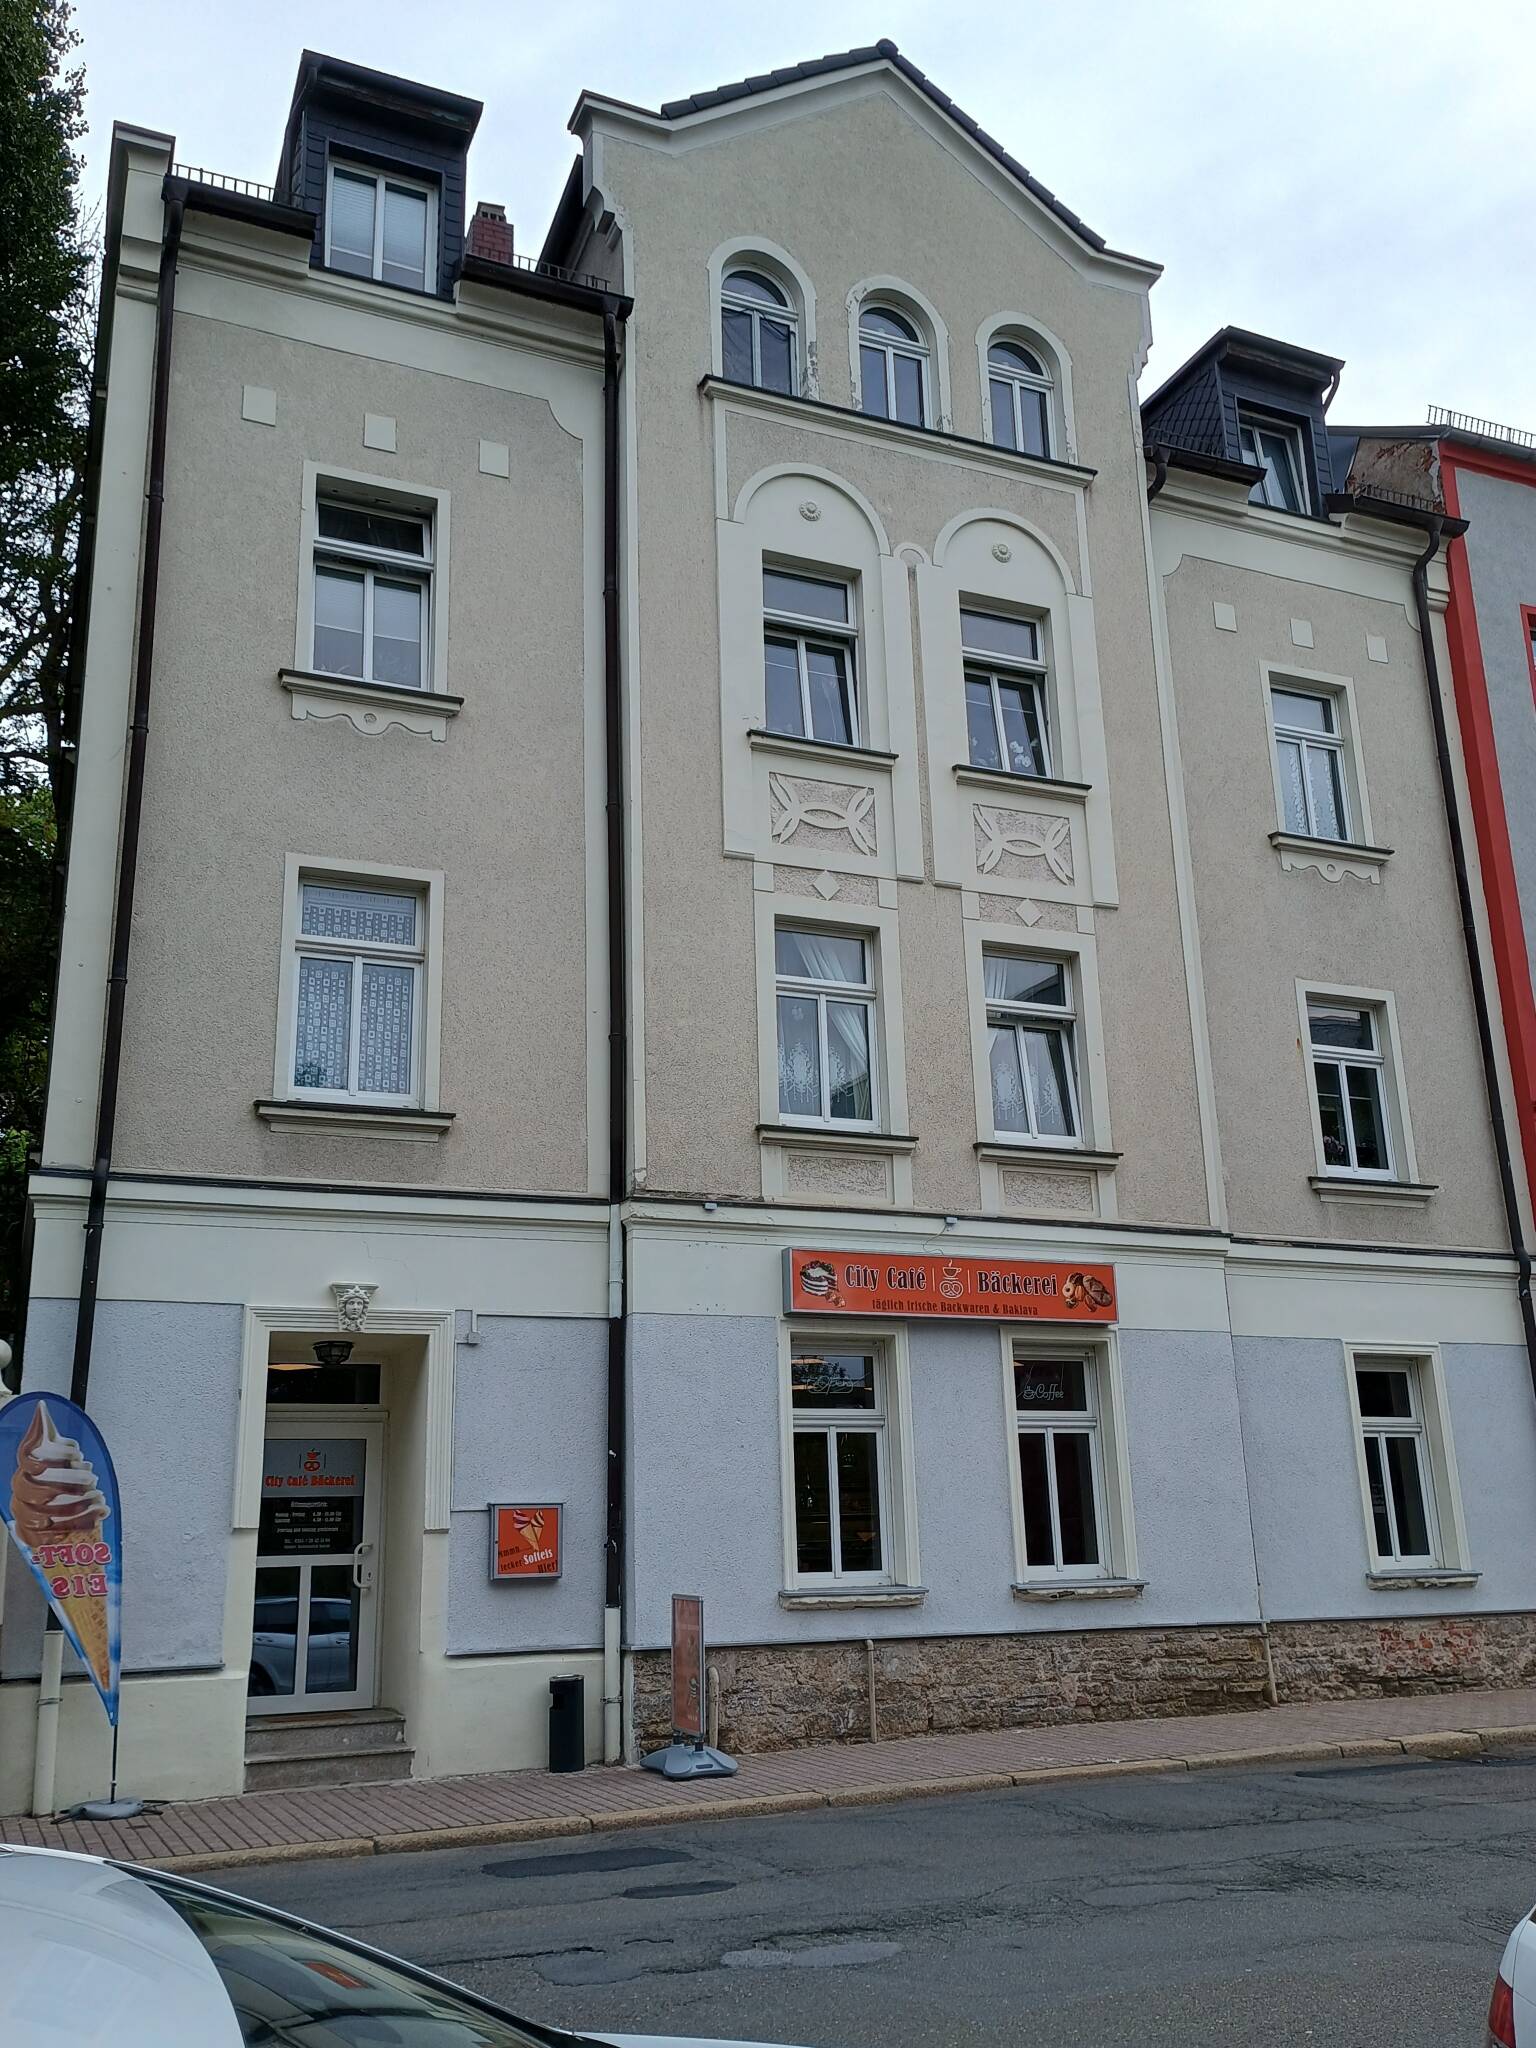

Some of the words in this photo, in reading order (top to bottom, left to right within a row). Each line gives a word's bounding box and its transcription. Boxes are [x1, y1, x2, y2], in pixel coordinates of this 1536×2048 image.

[845, 1264, 880, 1291] City
[886, 1265, 926, 1290] Café
[977, 1270, 1059, 1297] Bäckerei
[940, 1301, 990, 1314] Backwaren
[1002, 1304, 1038, 1316] Baklava
[1036, 1383, 1064, 1400] Coffee
[523, 1548, 553, 1565] Softeis
